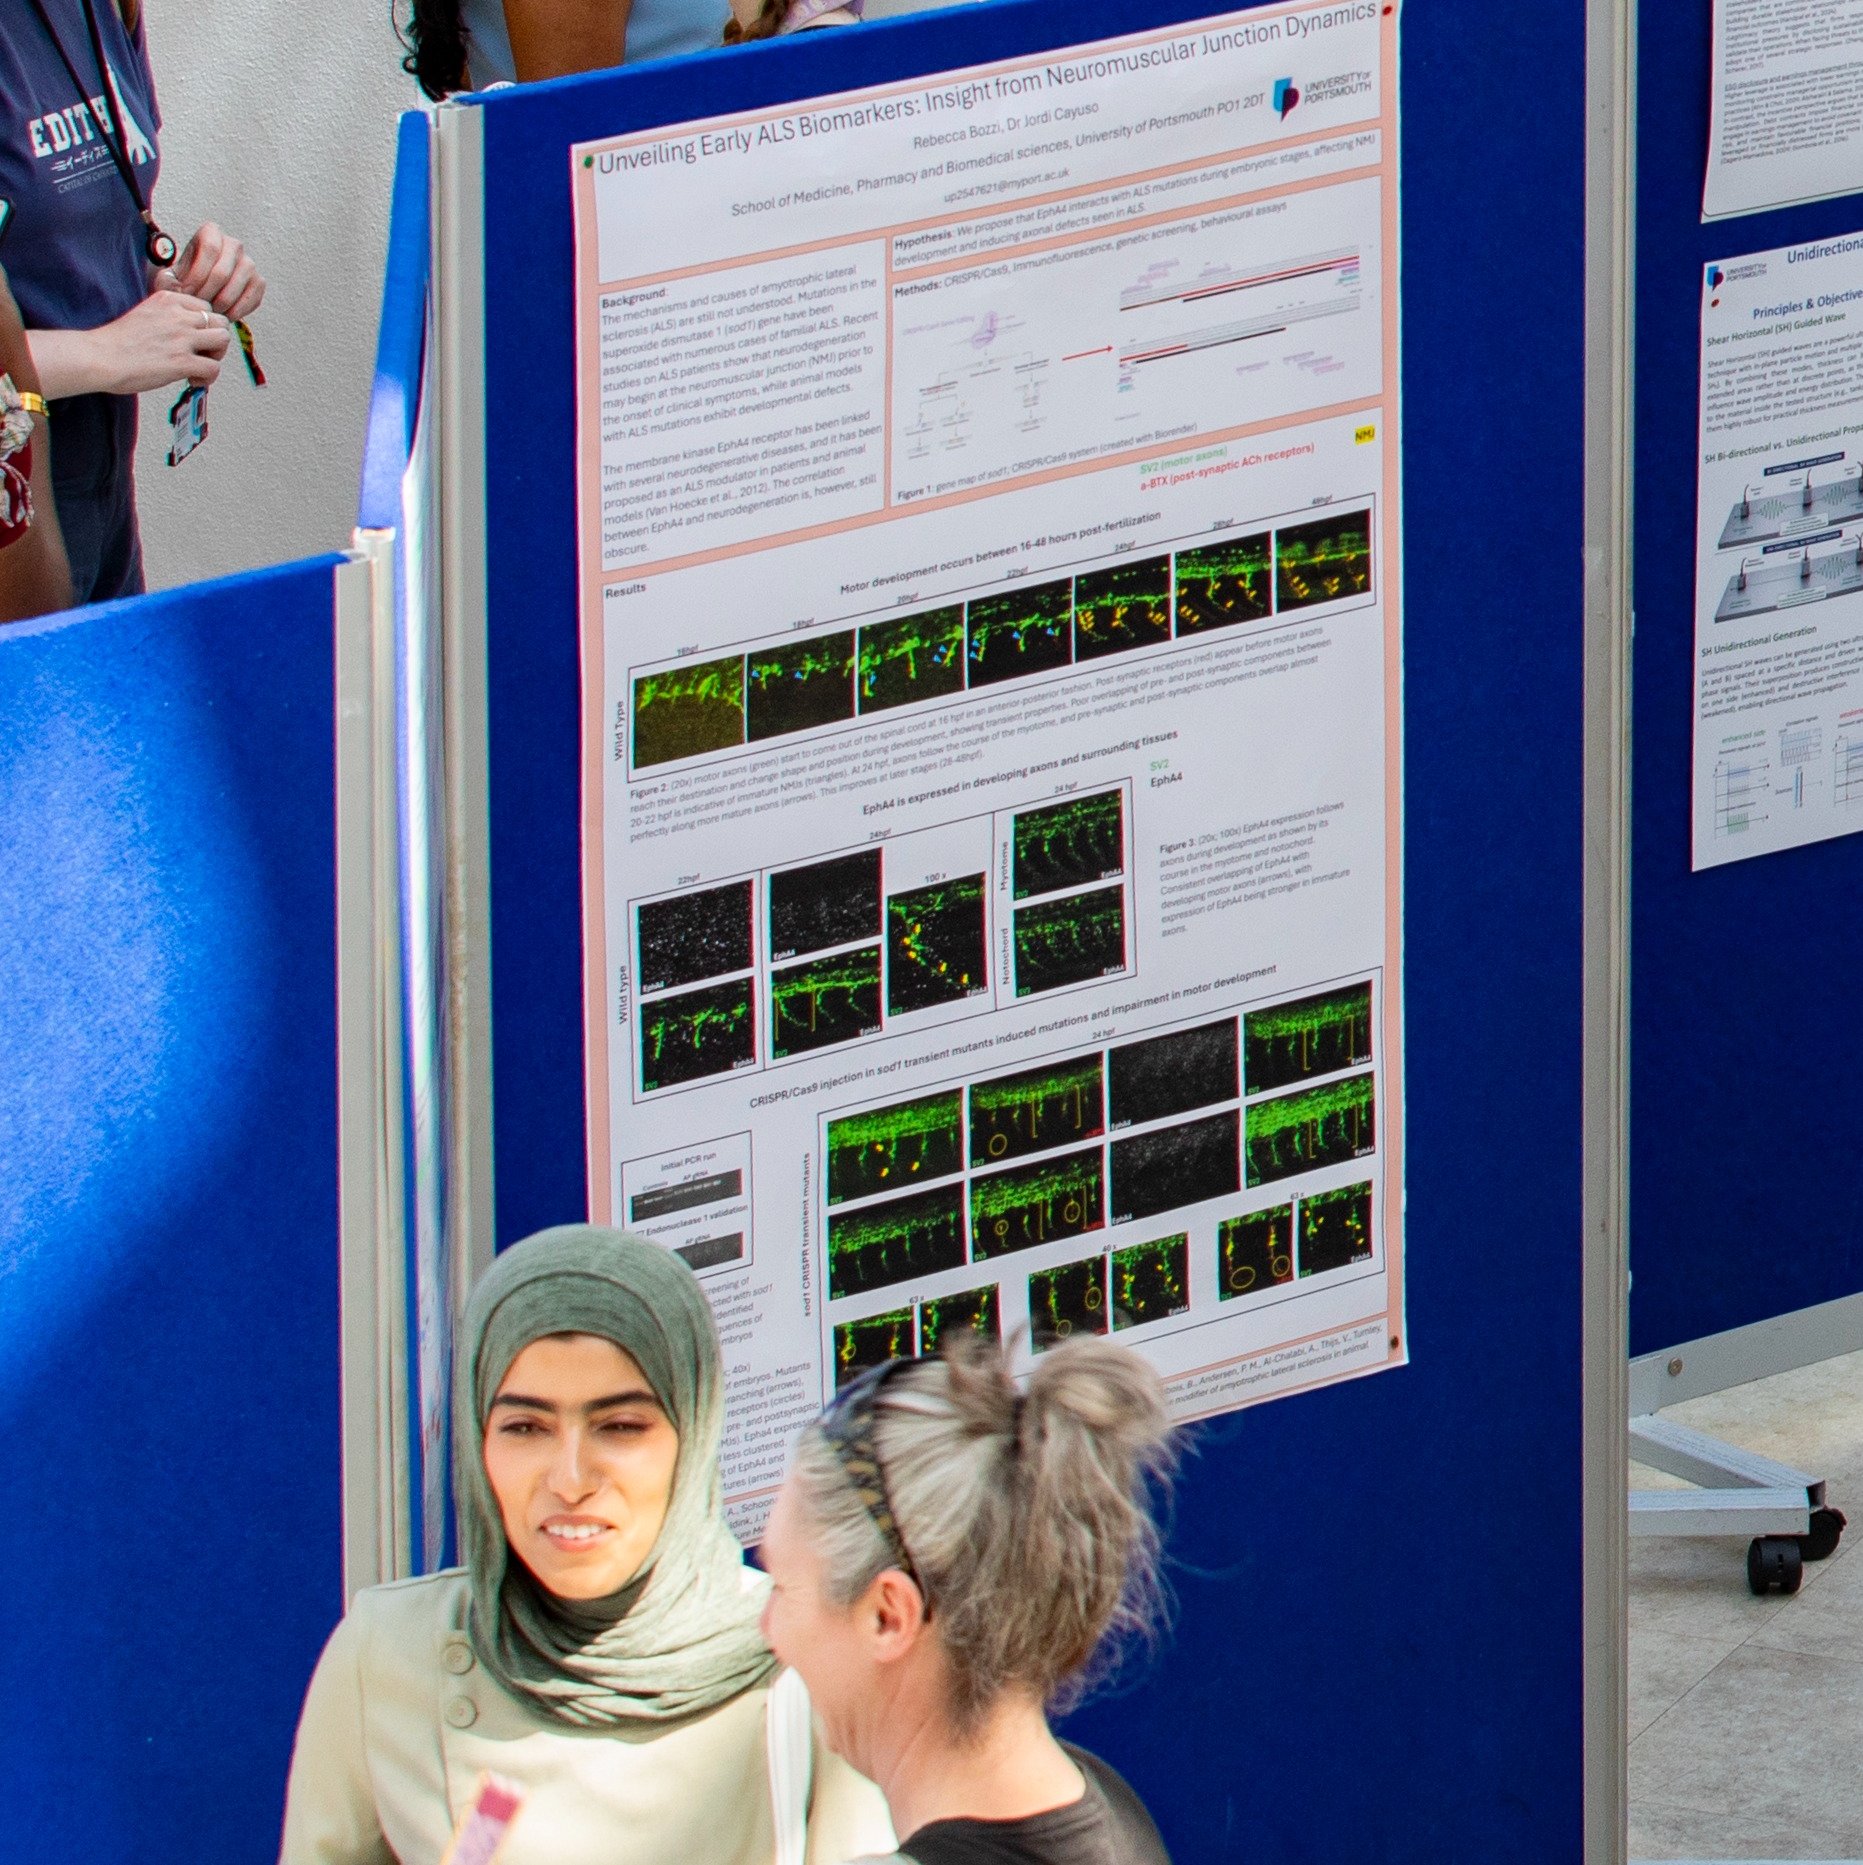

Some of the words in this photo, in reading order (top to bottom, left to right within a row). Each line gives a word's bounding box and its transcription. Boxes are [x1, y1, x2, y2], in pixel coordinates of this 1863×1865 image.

[28, 95, 114, 159] EDITH
[598, 137, 697, 176] Unveiling
[700, 122, 752, 156] Early
[757, 118, 796, 146] ALS
[799, 96, 923, 138] Biomarkers:
[925, 80, 993, 113] Insight
[991, 63, 1045, 98] from
[1043, 41, 1196, 87] Neuromuscular
[1202, 23, 1281, 56] Junction
[1285, 2, 1376, 39] Dynamics
